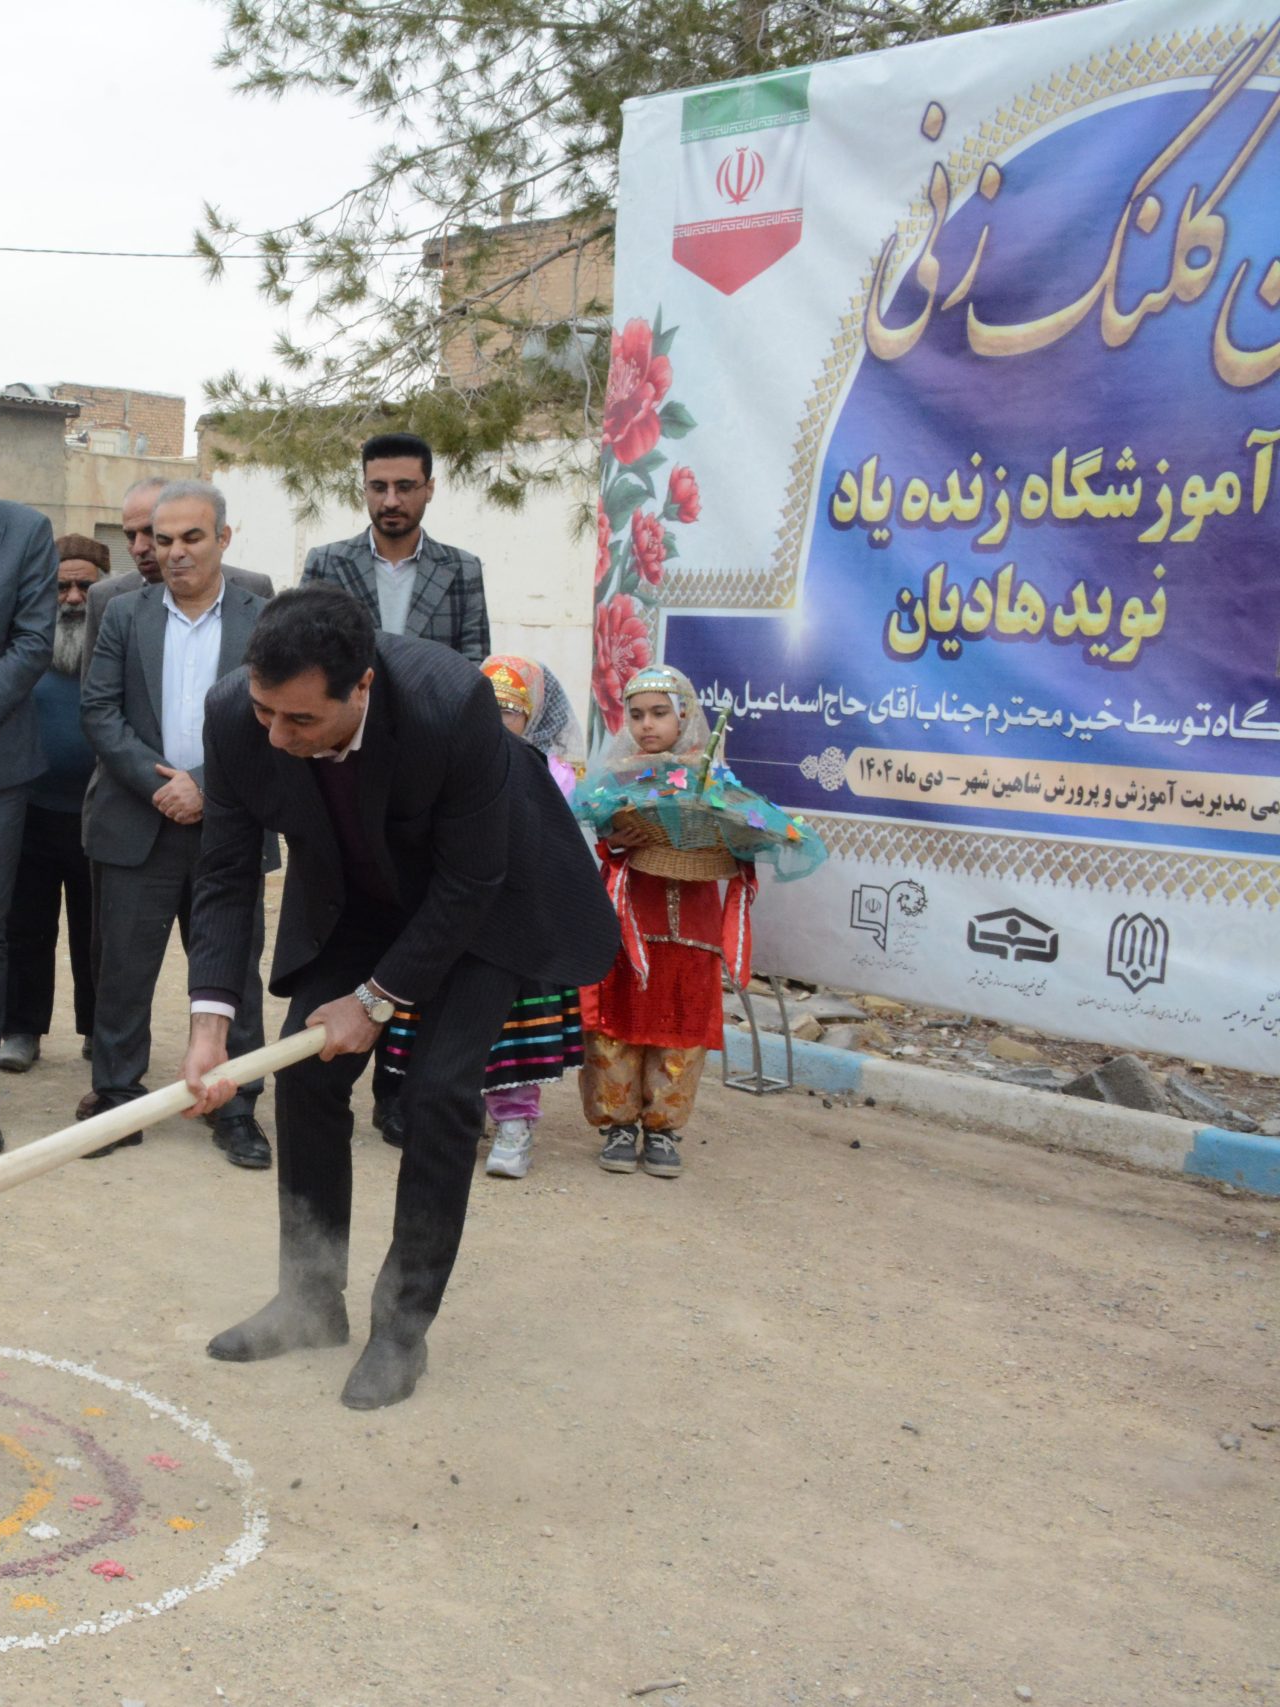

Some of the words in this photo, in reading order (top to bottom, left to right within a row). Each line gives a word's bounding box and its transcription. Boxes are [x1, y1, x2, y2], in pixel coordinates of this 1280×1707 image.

[1021, 427, 1280, 543] آموزشگاه
[887, 562, 1047, 656] هادیان
[1052, 562, 1168, 662] نوید
[733, 679, 824, 720] اسماعیل
[823, 684, 868, 727] حاج
[868, 684, 918, 725] آقای
[916, 691, 985, 733] جناب
[985, 696, 1063, 736] محترم
[1062, 698, 1122, 741] خیر
[1124, 699, 1212, 746] توسط
[896, 762, 917, 784] ماه
[918, 775, 944, 792] دی
[960, 768, 990, 796] شهر
[992, 770, 1042, 799] شاهین
[1044, 774, 1099, 808] پرورش
[1103, 784, 1112, 807] و
[1115, 779, 1177, 812] آموزش
[1181, 789, 1247, 817] مدیریت
